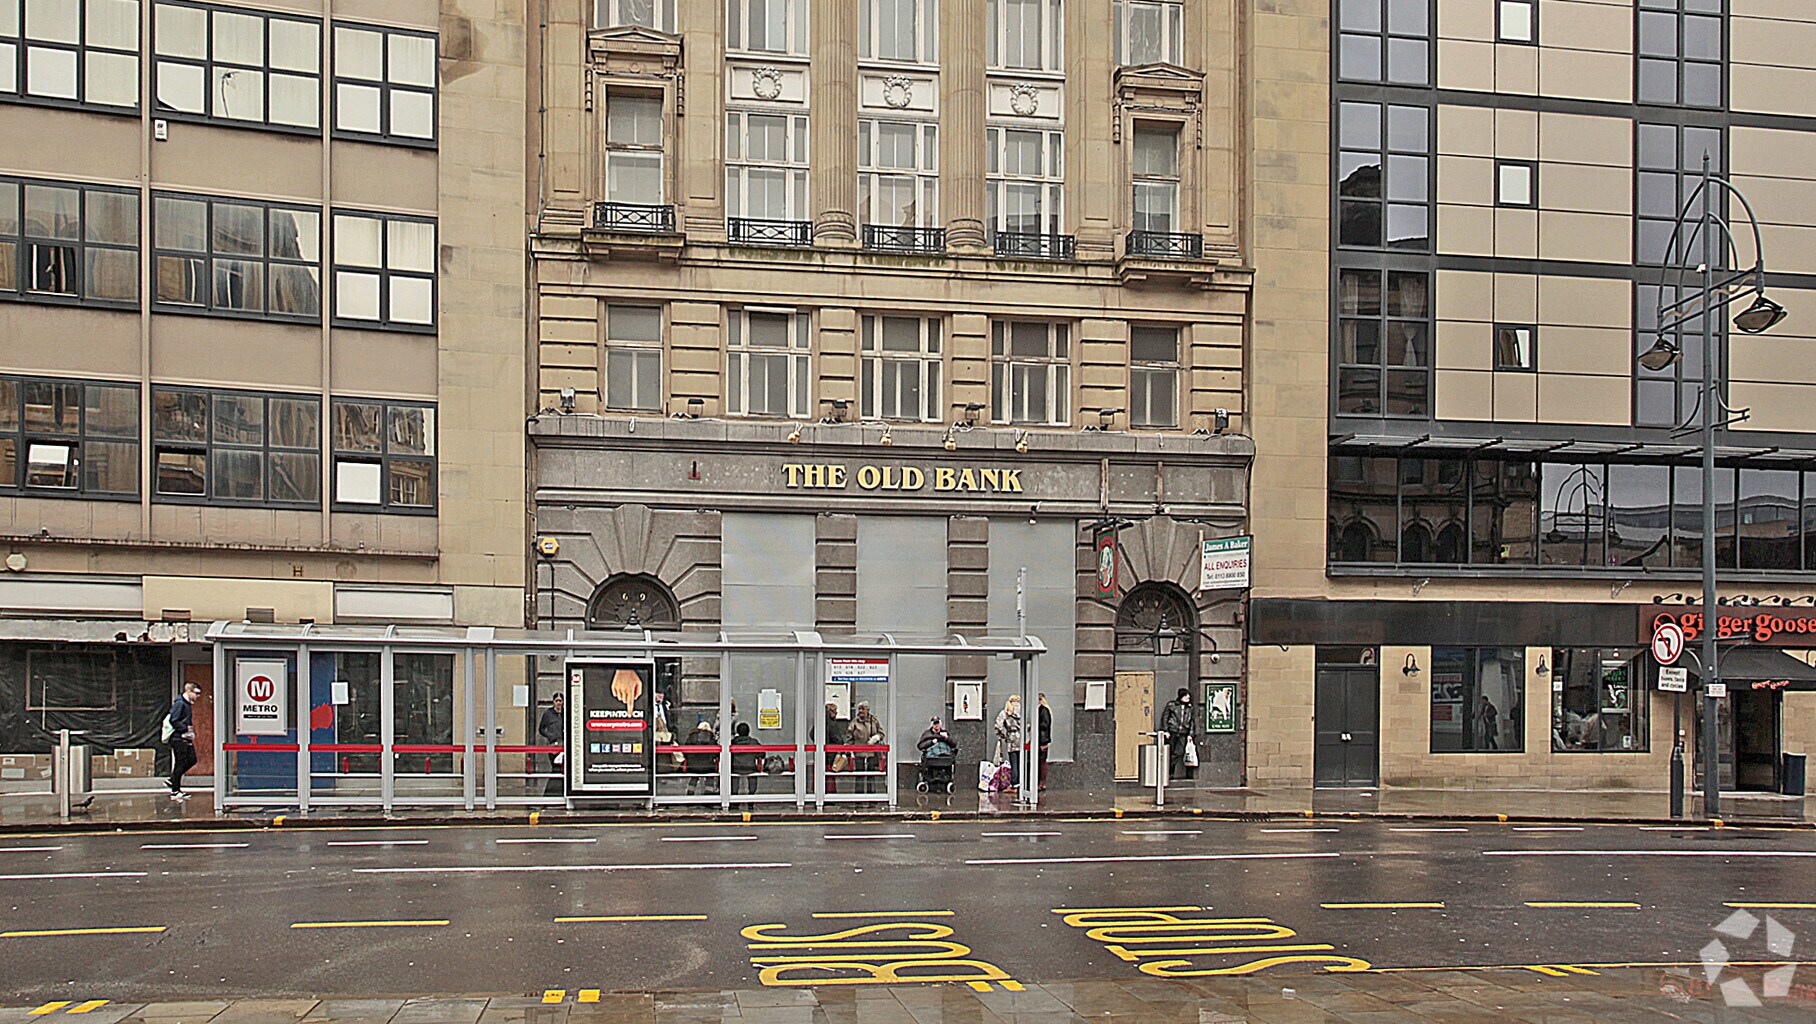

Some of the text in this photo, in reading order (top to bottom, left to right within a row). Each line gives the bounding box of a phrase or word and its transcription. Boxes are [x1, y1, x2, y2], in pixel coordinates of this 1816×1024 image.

[782, 464, 1023, 493] THE OLD BANK
[1205, 540, 1248, 552] James A Baker
[1204, 559, 1247, 571] ALL ENQUIRIES
[1680, 613, 1752, 641] giger
[250, 680, 271, 697] M
[243, 704, 278, 713] METRO
[740, 912, 1372, 986] BUS STOP
